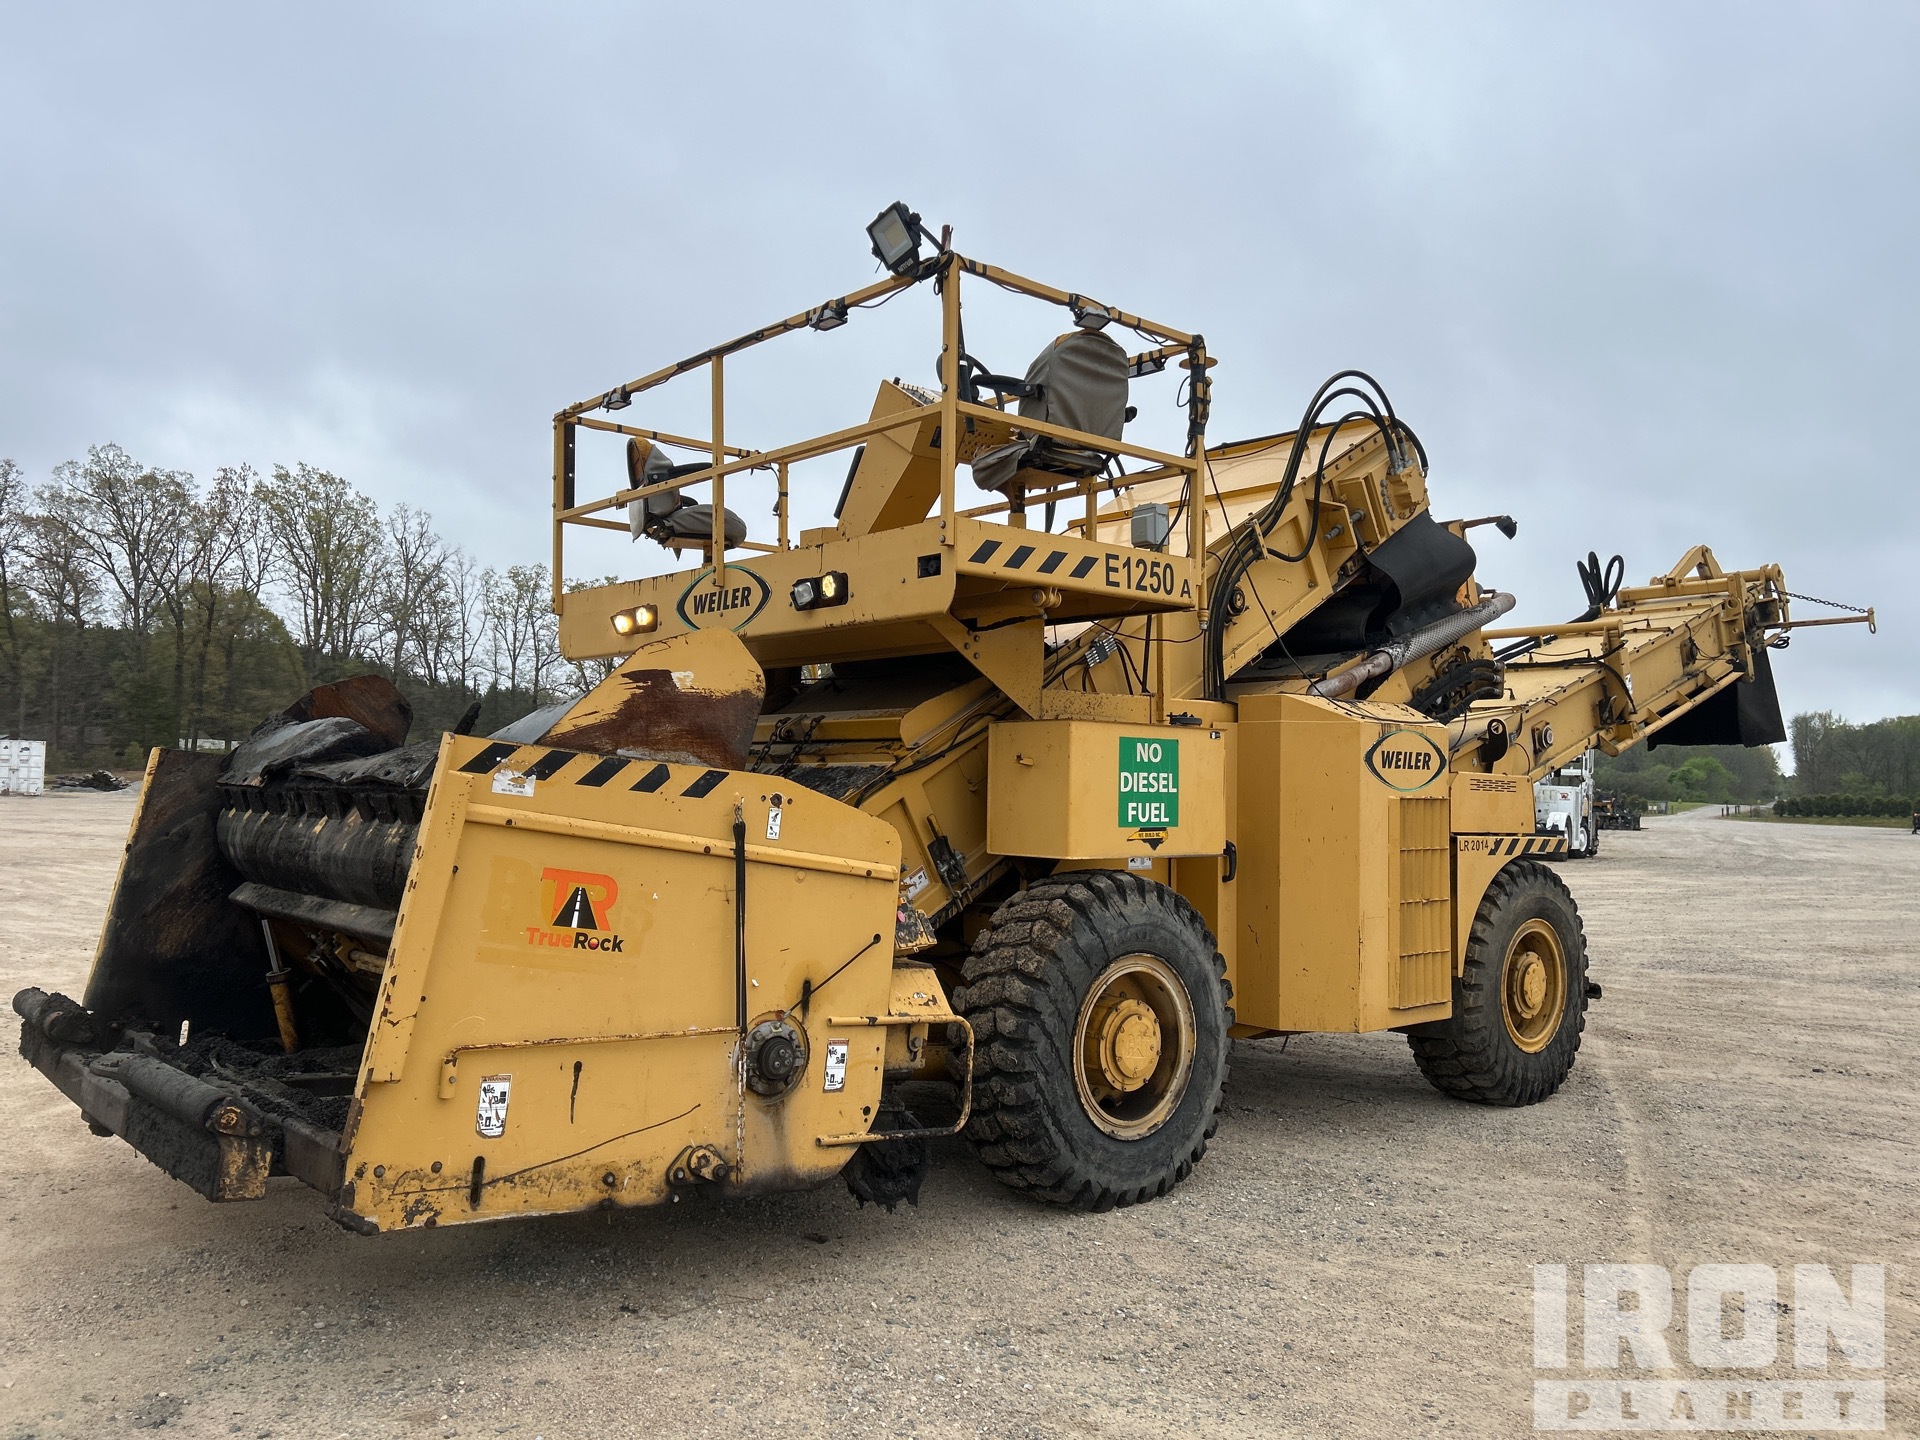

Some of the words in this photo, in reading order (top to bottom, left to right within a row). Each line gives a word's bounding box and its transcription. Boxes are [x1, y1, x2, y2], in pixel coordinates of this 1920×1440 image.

[1105, 553, 1174, 595] E1250
[1180, 579, 1191, 599] A
[693, 586, 752, 615] WEILER
[1136, 742, 1162, 763] NO
[1381, 750, 1431, 770] WEILER
[1120, 771, 1177, 793] DIESEL
[1127, 802, 1169, 823] FUEL
[1459, 840, 1469, 852] LR
[1471, 839, 1489, 851] 2014
[526, 927, 624, 952] TrueRock
